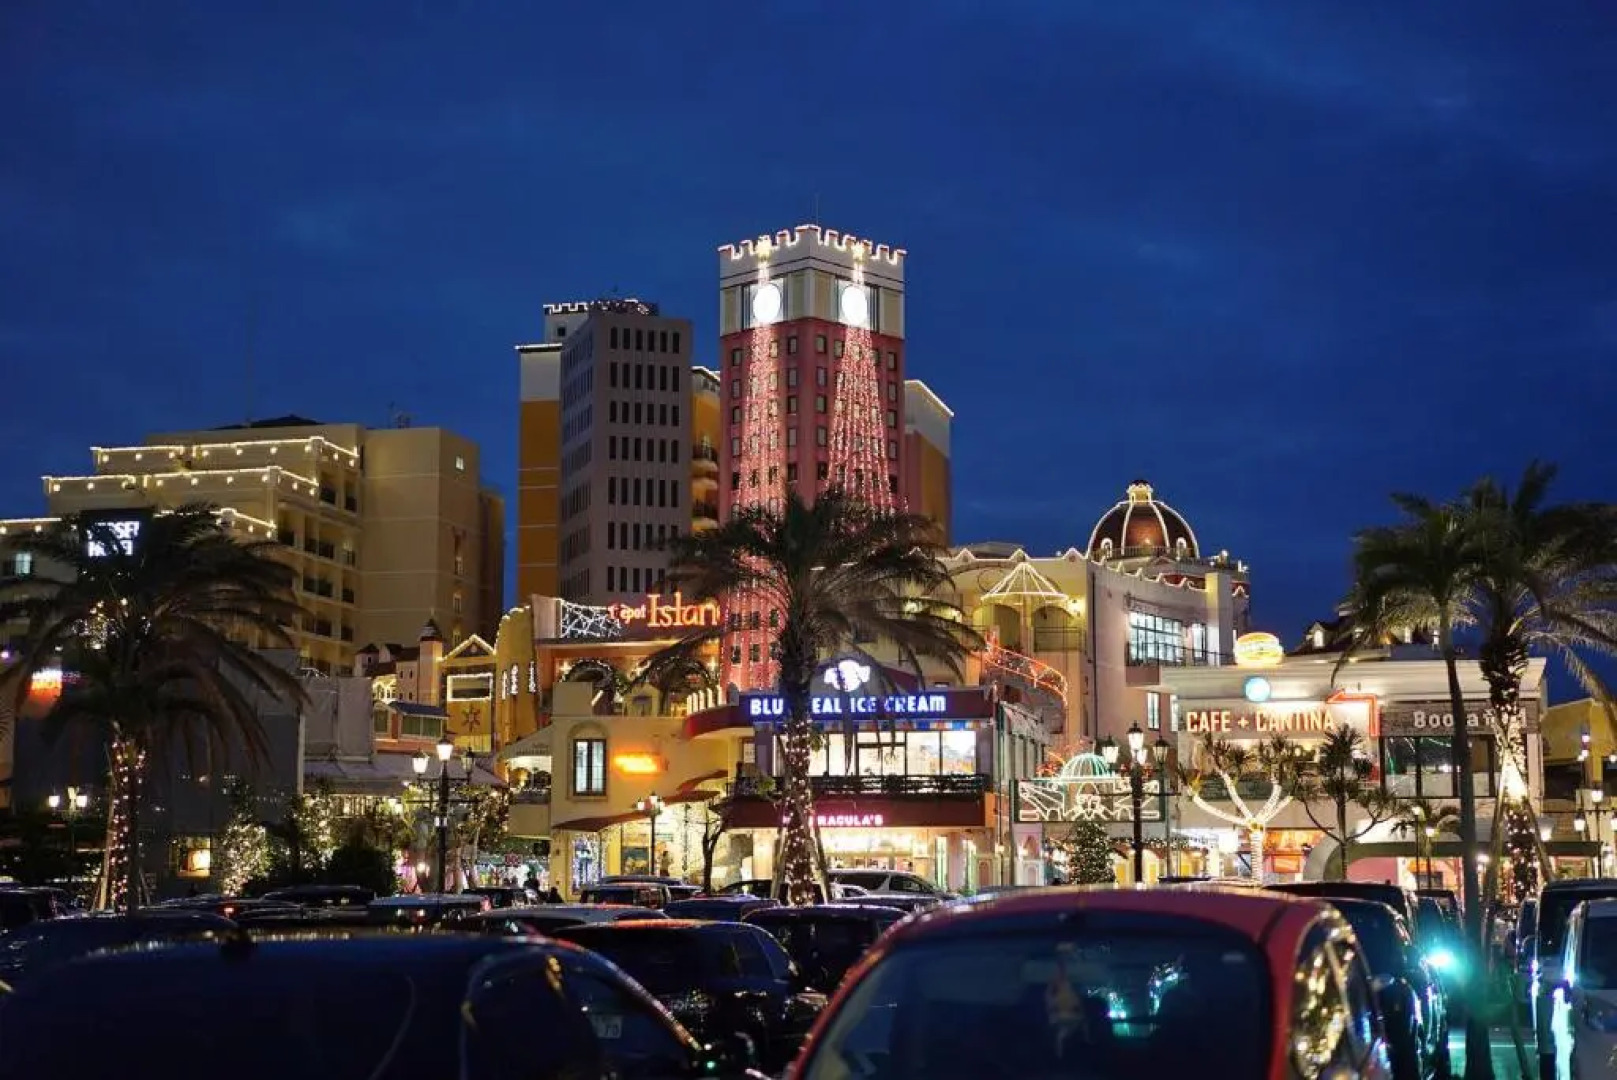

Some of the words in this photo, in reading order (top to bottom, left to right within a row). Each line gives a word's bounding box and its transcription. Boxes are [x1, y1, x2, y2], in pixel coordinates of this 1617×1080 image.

[647, 592, 721, 627] Islan
[750, 698, 784, 716] BLU
[811, 697, 843, 714] EAL
[850, 697, 877, 713] ICE
[884, 695, 947, 712] CREAM
[1186, 711, 1231, 732] CAFE
[1255, 711, 1337, 731] CANTINA
